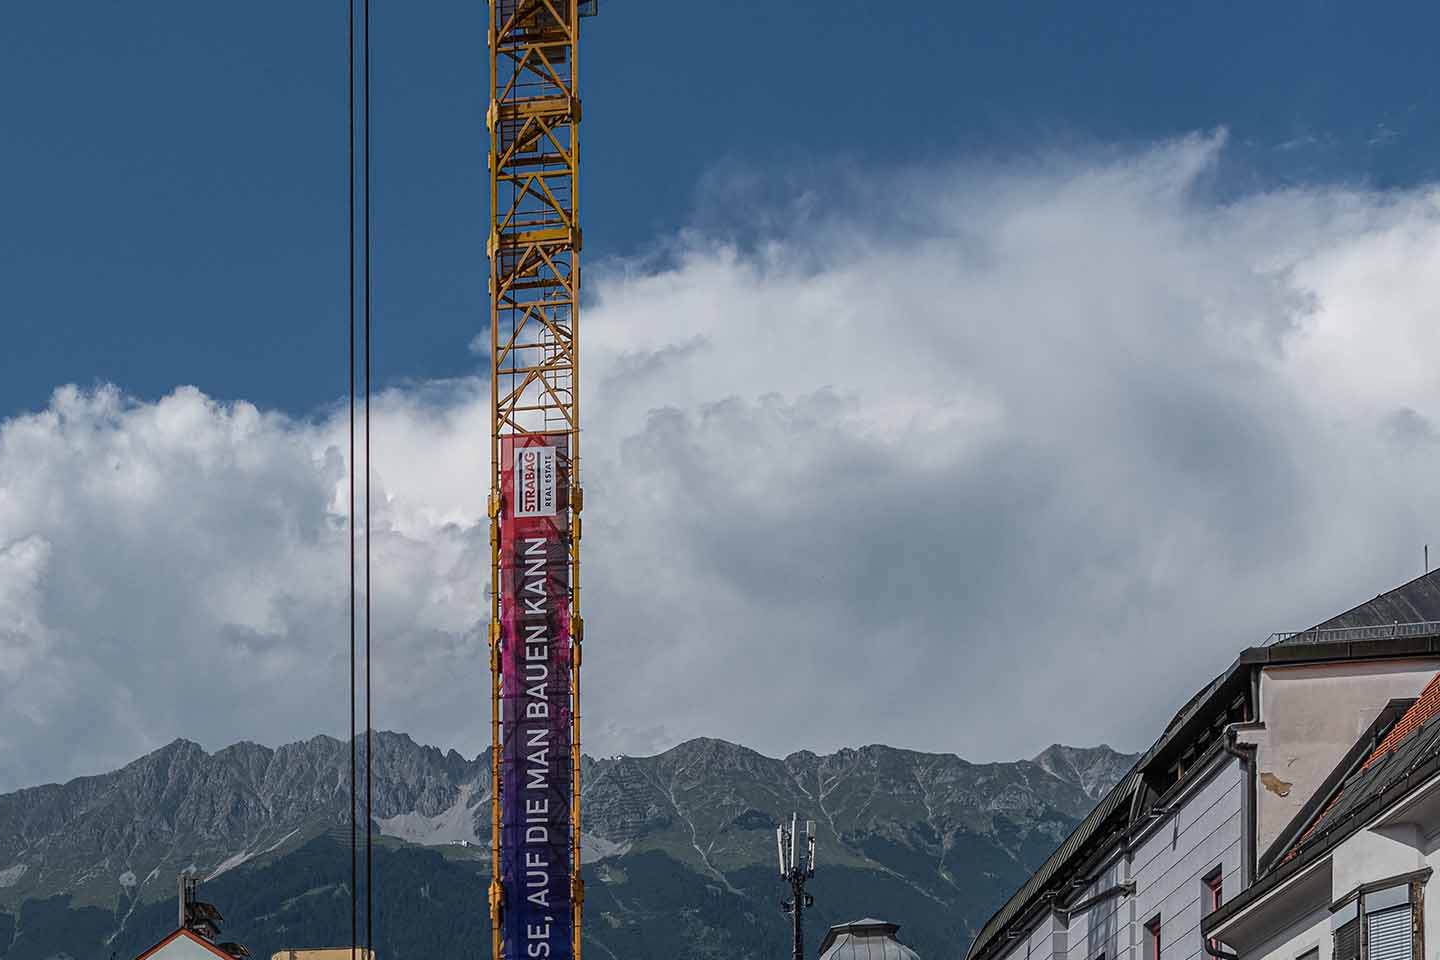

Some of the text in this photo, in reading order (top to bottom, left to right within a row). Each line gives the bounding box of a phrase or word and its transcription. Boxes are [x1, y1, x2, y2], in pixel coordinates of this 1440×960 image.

[524, 452, 536, 512] STRABAG
[525, 537, 547, 615] KANN
[525, 625, 548, 718] BAUEN
[526, 729, 549, 790] MAN
[526, 799, 549, 842] DIE
[526, 853, 549, 907] AUF
